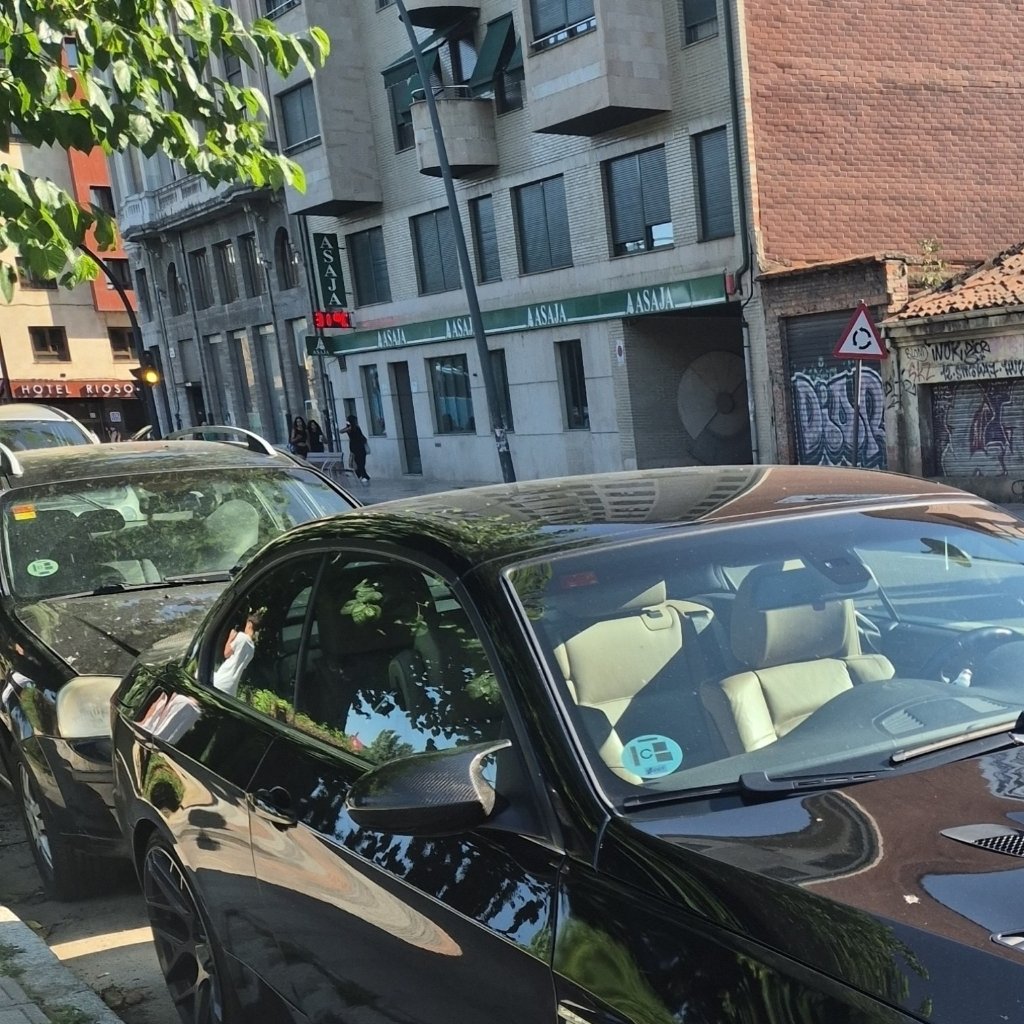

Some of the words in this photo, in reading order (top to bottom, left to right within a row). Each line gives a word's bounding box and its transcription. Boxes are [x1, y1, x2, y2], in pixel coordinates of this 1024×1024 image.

[320, 236, 342, 306] ASAJA
[636, 286, 675, 313] ASAJA
[535, 303, 568, 327] ASAJA
[383, 328, 407, 347] ASAJA
[452, 316, 476, 338] ASAJ
[21, 384, 72, 394] HOTEL
[86, 383, 134, 393] RIOSO
